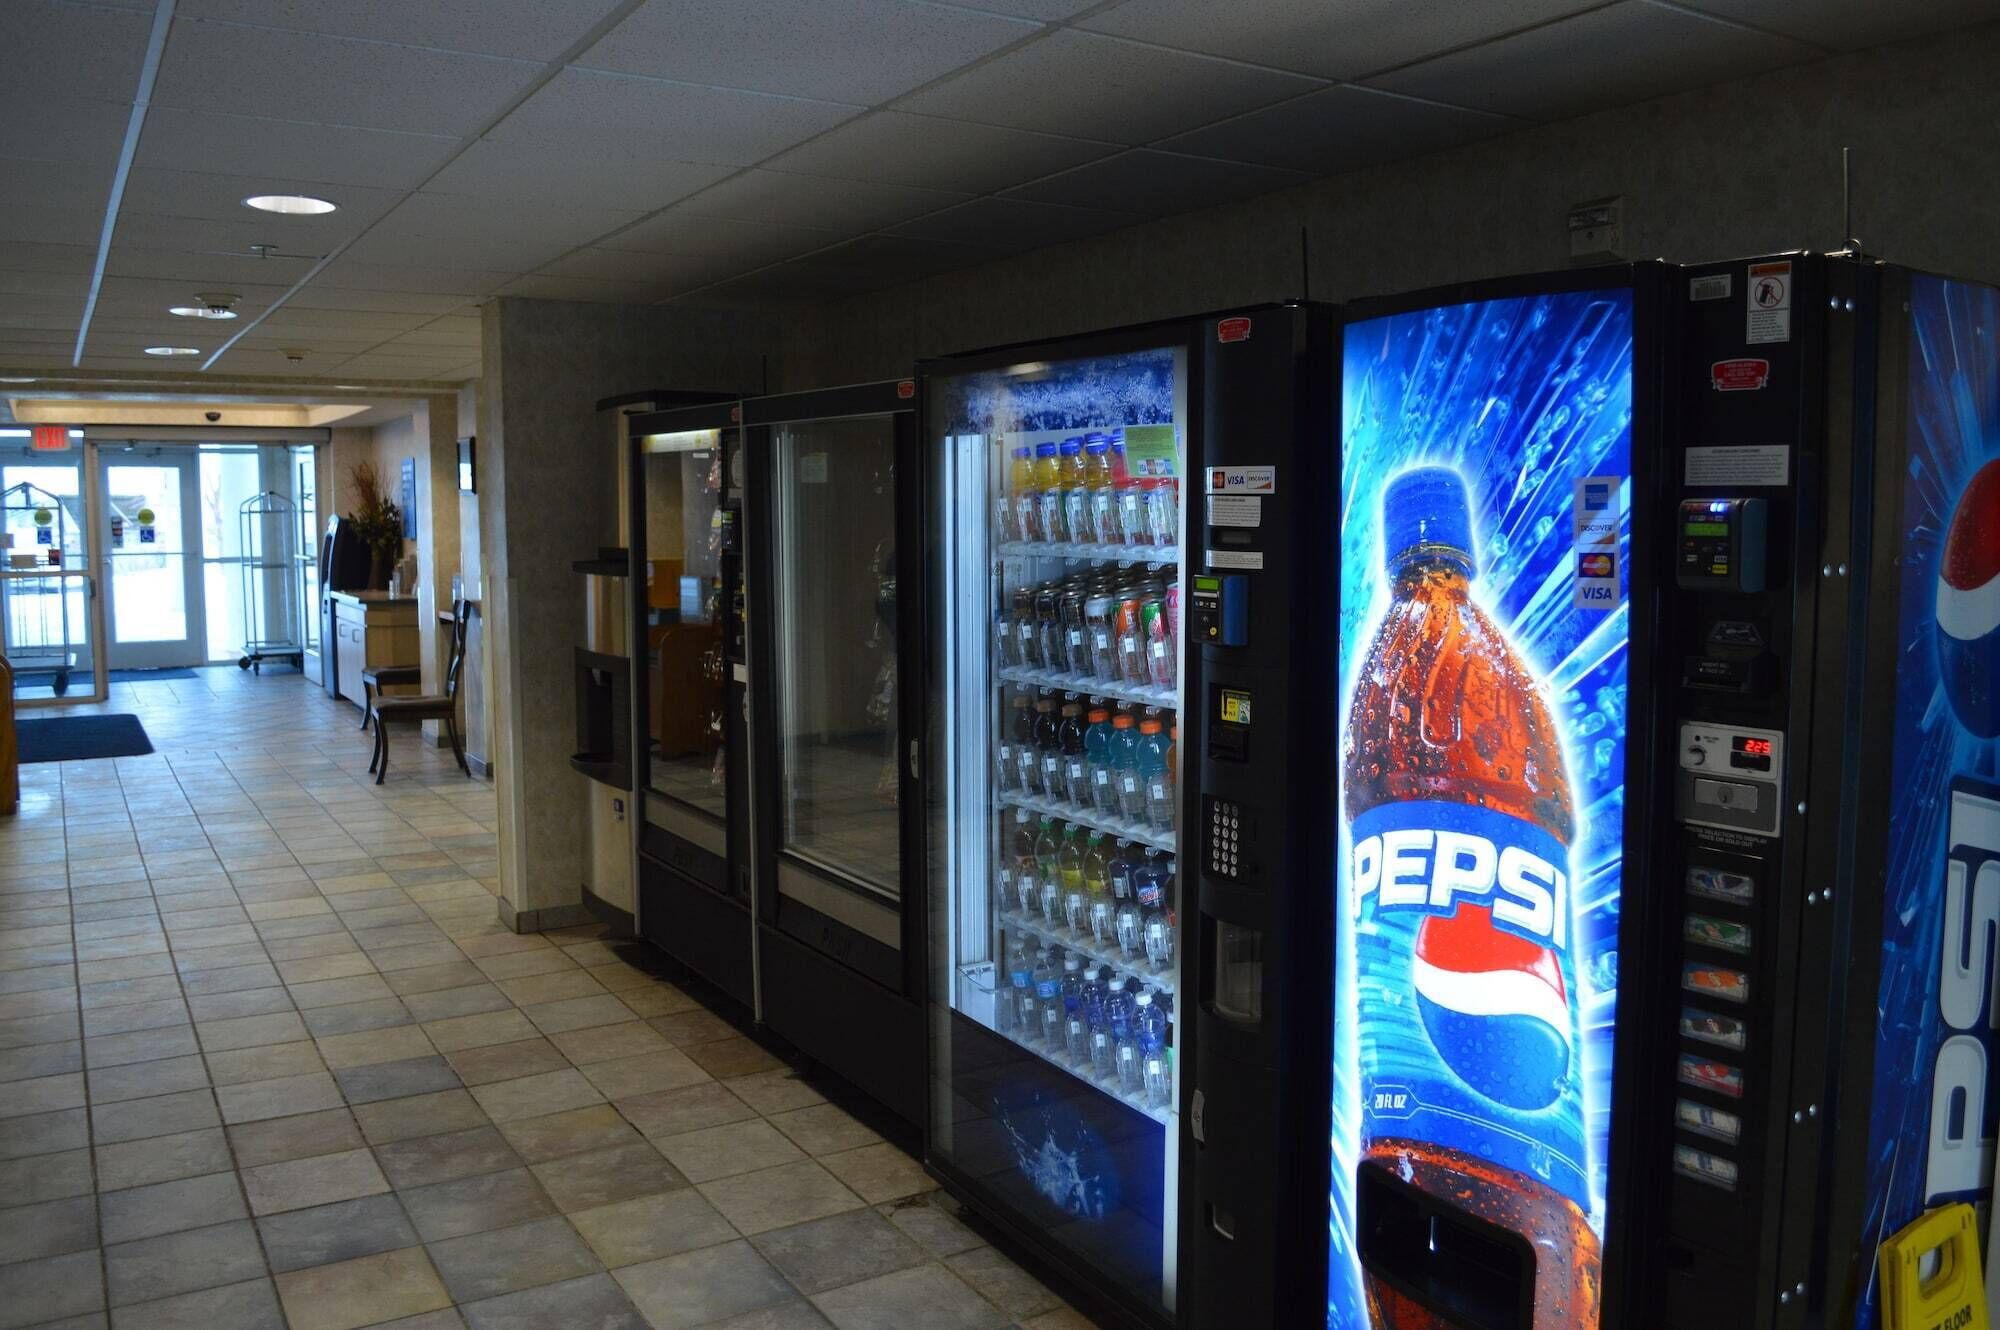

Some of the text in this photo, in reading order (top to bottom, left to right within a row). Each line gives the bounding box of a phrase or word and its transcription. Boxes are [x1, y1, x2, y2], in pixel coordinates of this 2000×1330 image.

[35, 426, 65, 449] EXIT
[1227, 475, 1245, 485] VISA
[1580, 524, 1612, 532] DISCOVER
[1582, 587, 1612, 600] VISA
[1353, 828, 1568, 951] PEPSI
[1394, 1094, 1407, 1109] OZ
[1944, 1303, 1972, 1330] FLOOR
